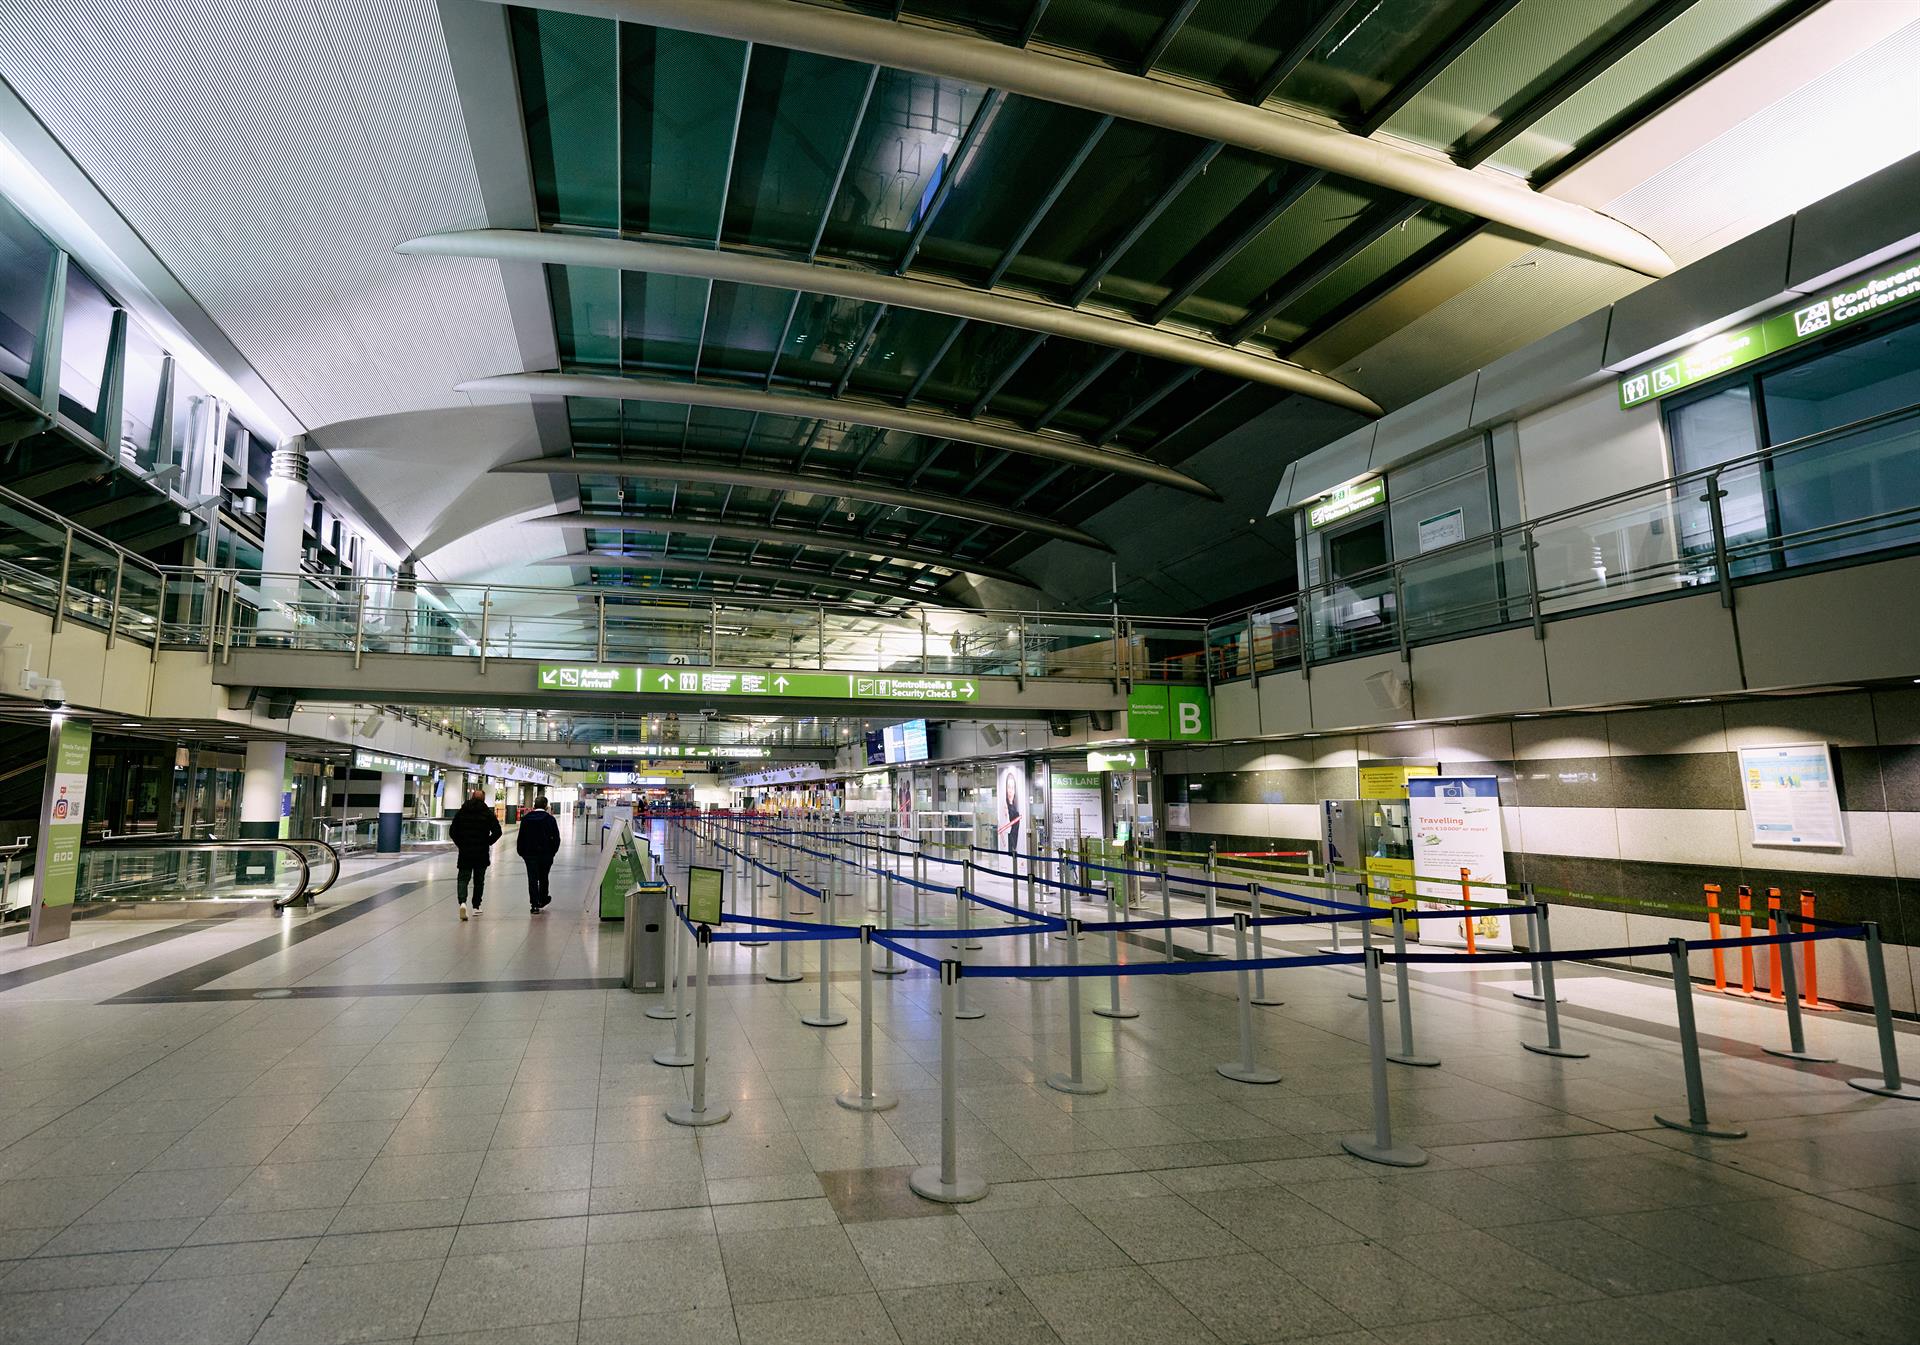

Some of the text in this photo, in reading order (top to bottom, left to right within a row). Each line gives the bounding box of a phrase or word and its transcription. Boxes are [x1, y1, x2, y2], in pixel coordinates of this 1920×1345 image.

[1832, 265, 1920, 308] Konferen
[580, 679, 612, 689] Arrival
[891, 680, 953, 690] Kontrollstelle B
[891, 688, 957, 699] Security Check B
[1178, 702, 1202, 735] B
[596, 773, 604, 783] A
[1052, 777, 1099, 786] FAST LANE
[1419, 816, 1463, 826] Travelling
